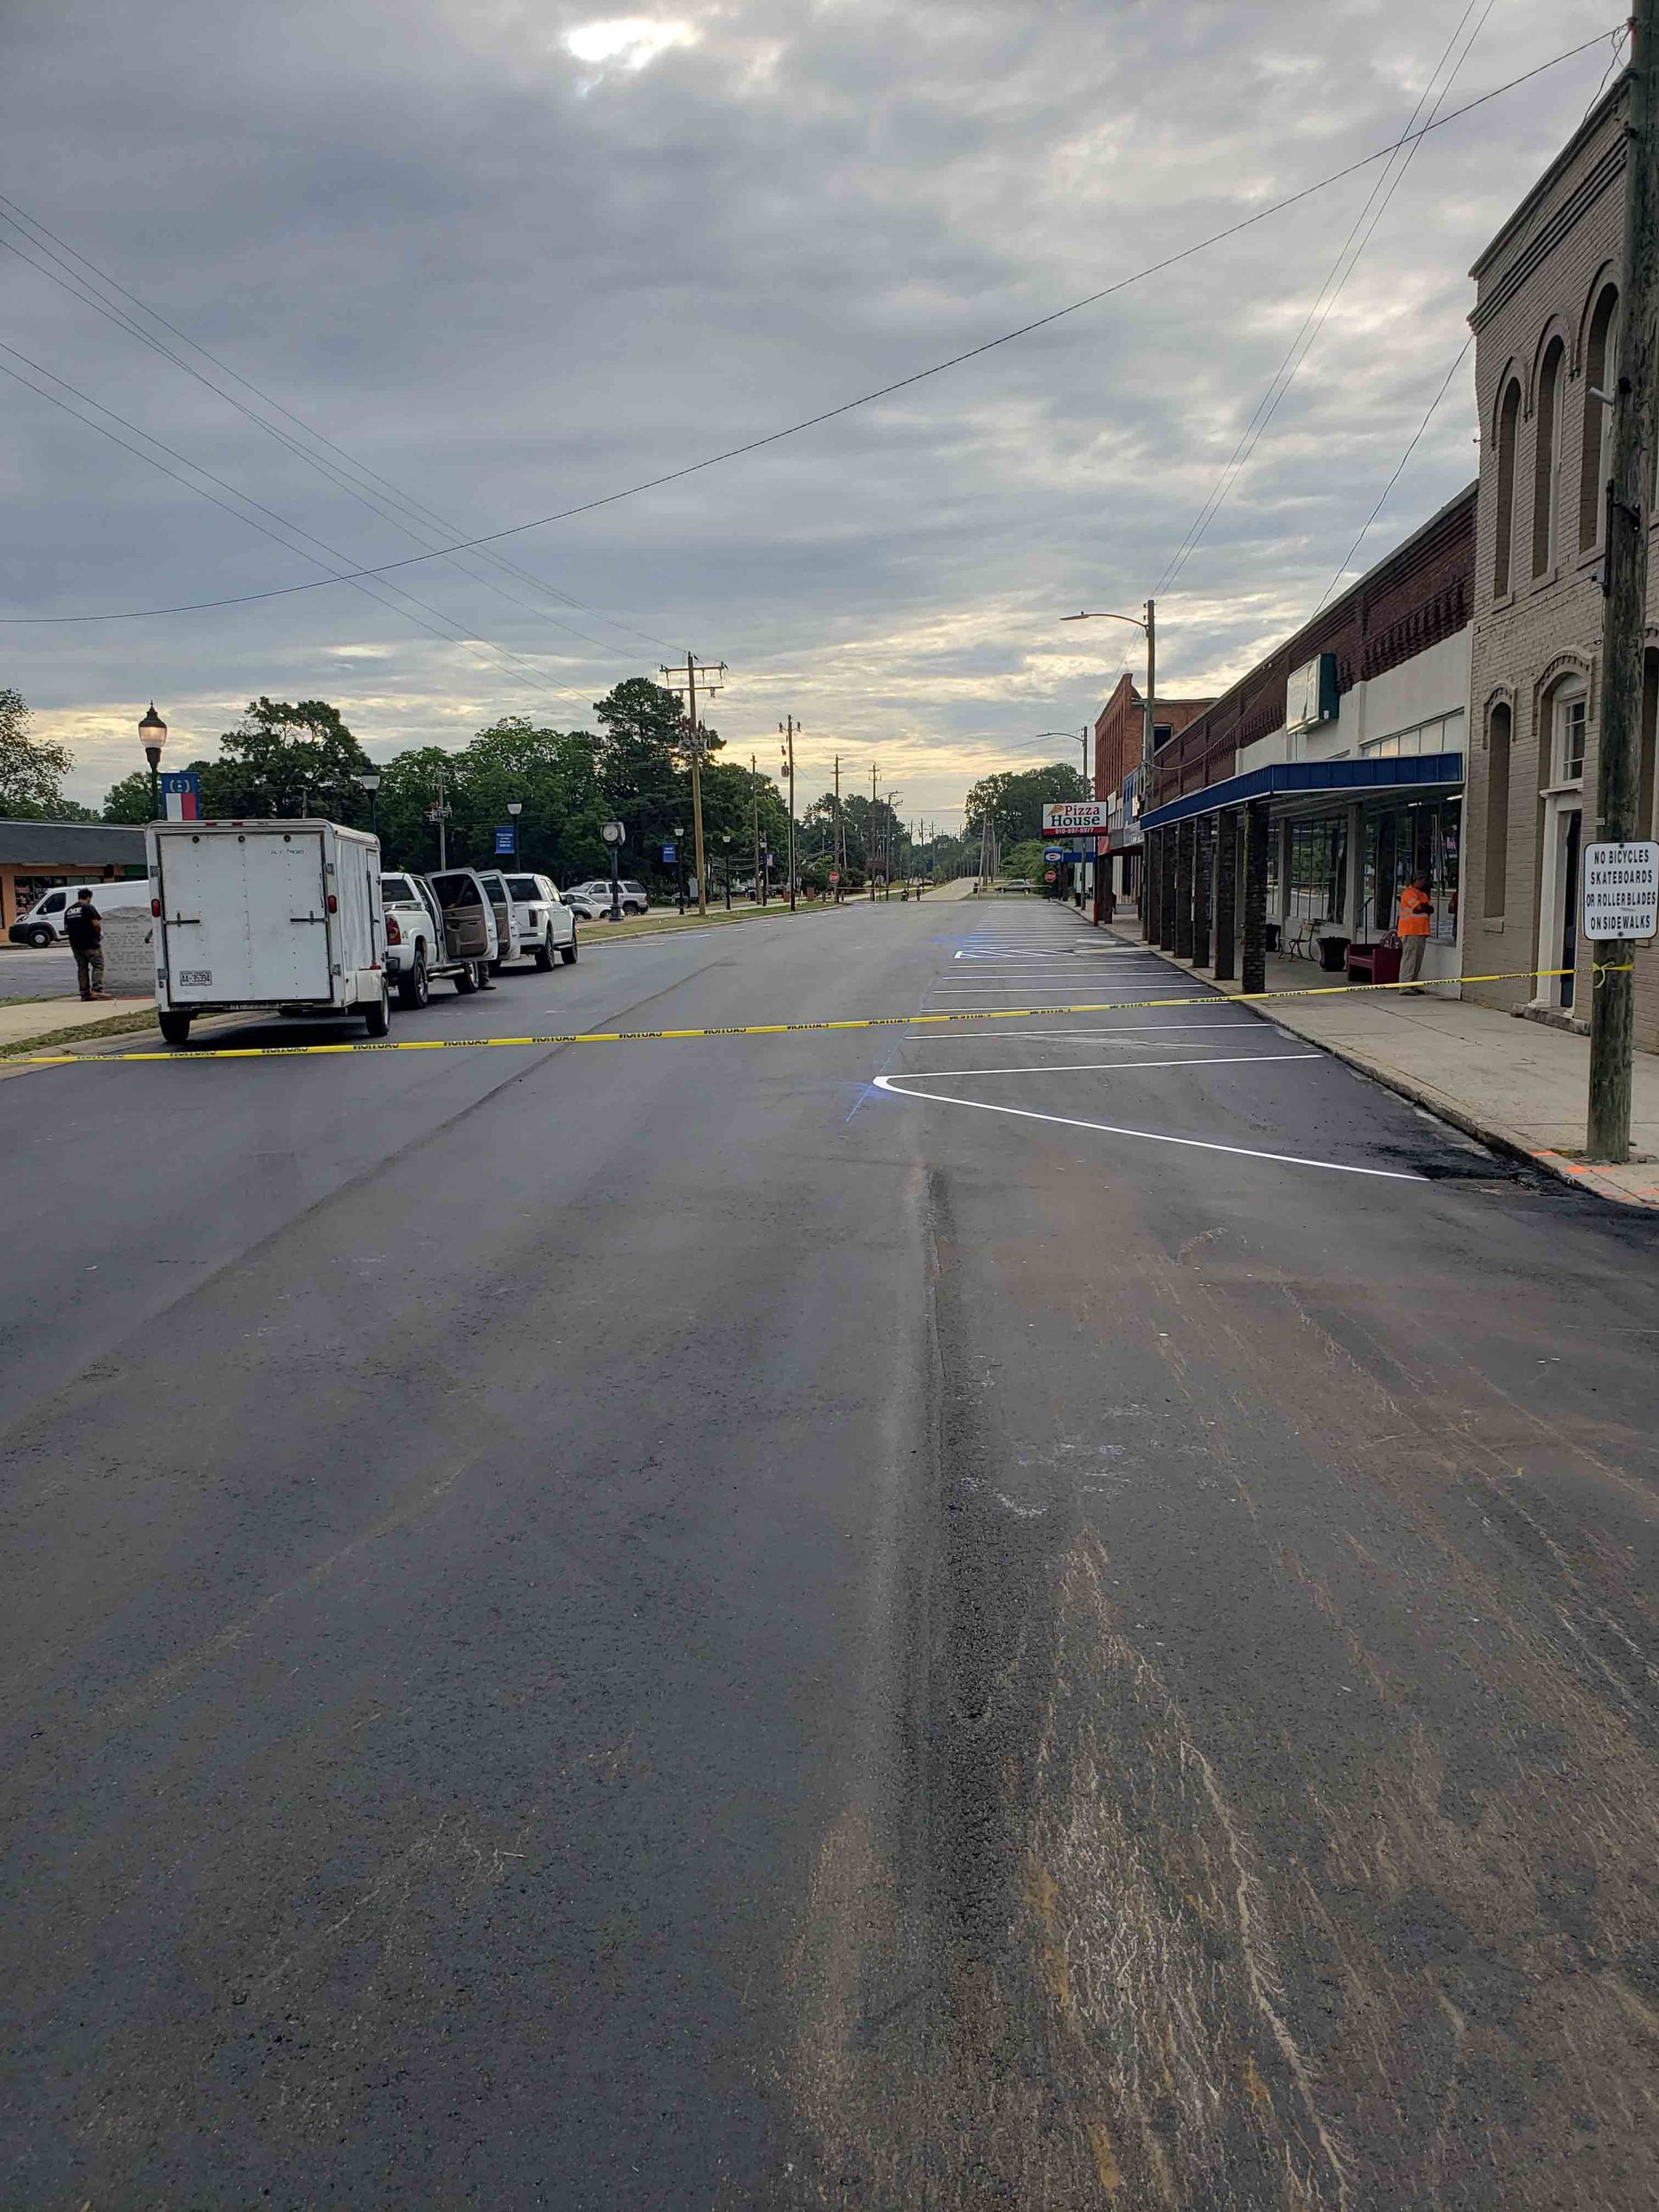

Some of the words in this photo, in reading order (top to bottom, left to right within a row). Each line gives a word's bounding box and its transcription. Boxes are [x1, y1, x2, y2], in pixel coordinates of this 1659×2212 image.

[1065, 805, 1100, 816] Pizza
[1052, 816, 1100, 827] House
[1594, 851, 1605, 864] NO
[1609, 849, 1649, 864] BICYCLES
[1591, 870, 1652, 885] SKATEBOARDS
[1586, 893, 1595, 907] OR
[1591, 917, 1601, 930] ON
[1603, 915, 1650, 930] SIDEWALKS
